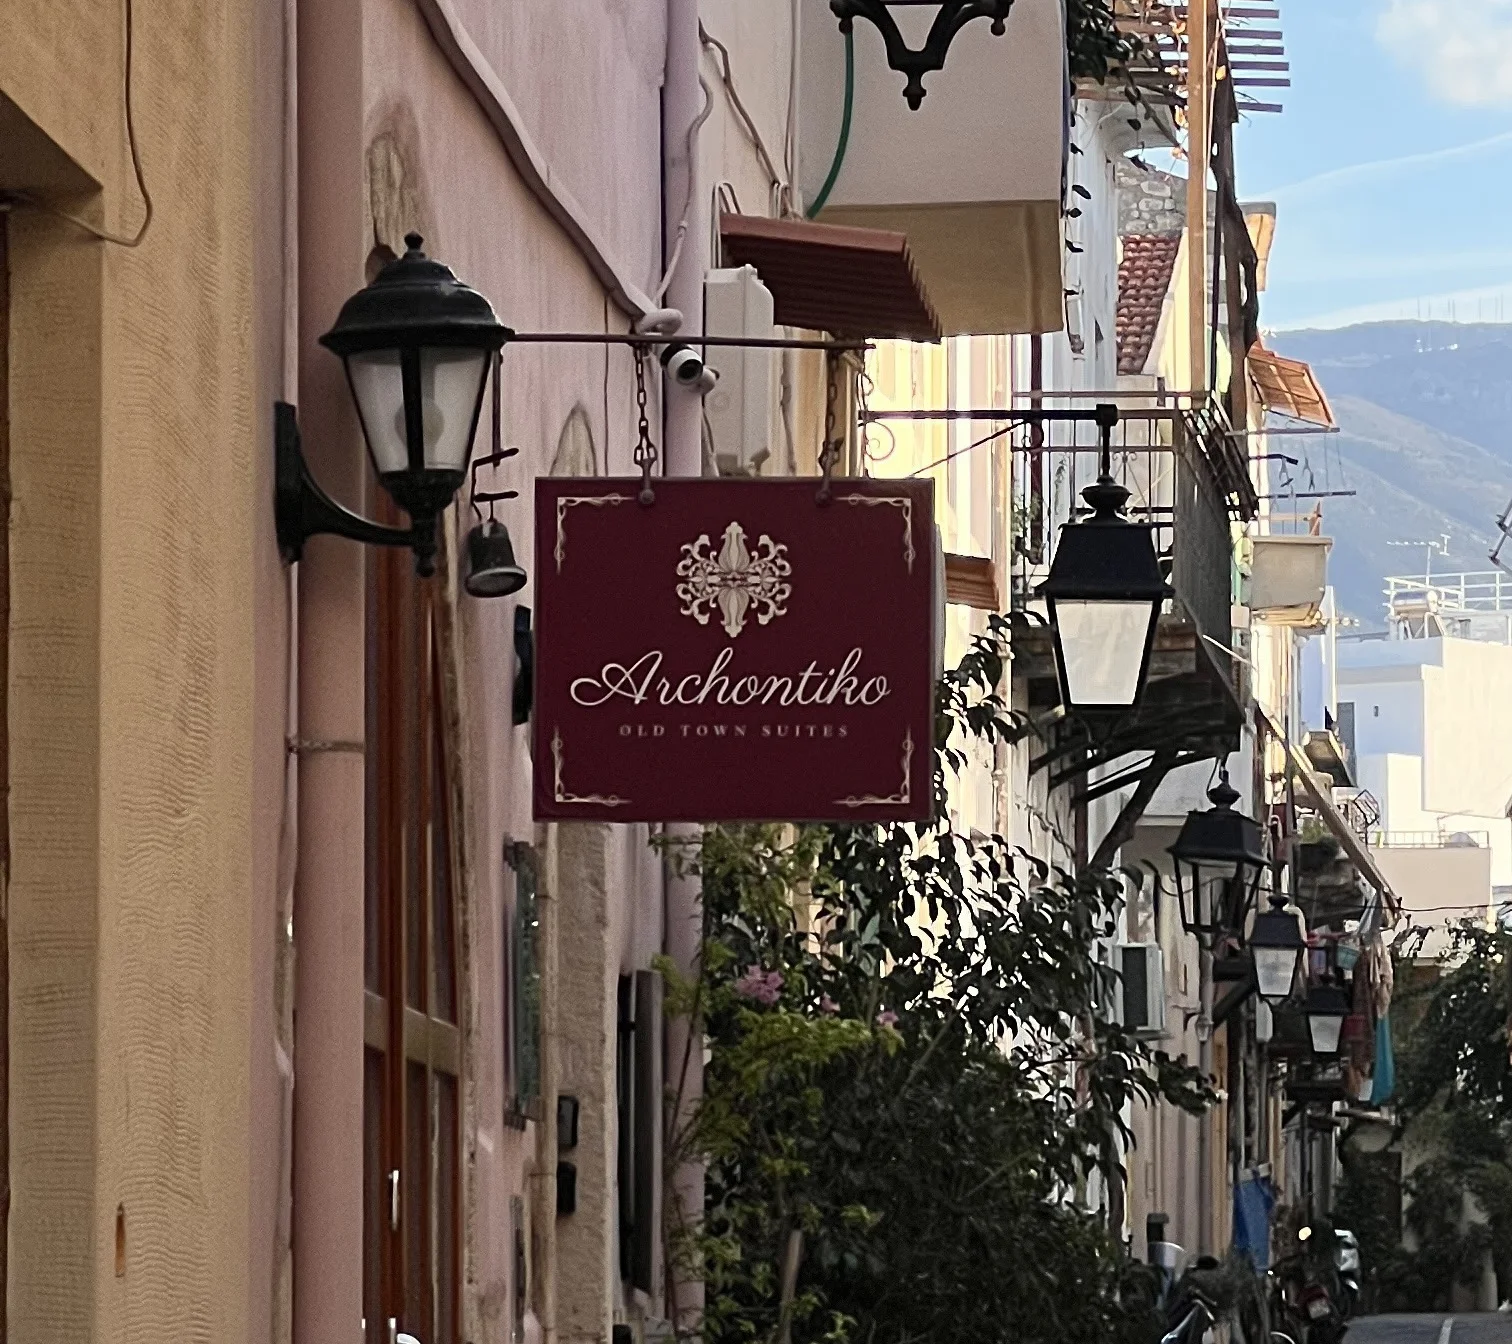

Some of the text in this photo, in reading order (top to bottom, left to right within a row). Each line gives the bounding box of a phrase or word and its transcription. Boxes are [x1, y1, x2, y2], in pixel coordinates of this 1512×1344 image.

[569, 646, 892, 707] Archontiko
[619, 724, 849, 738] OLD TOWN SUITES
